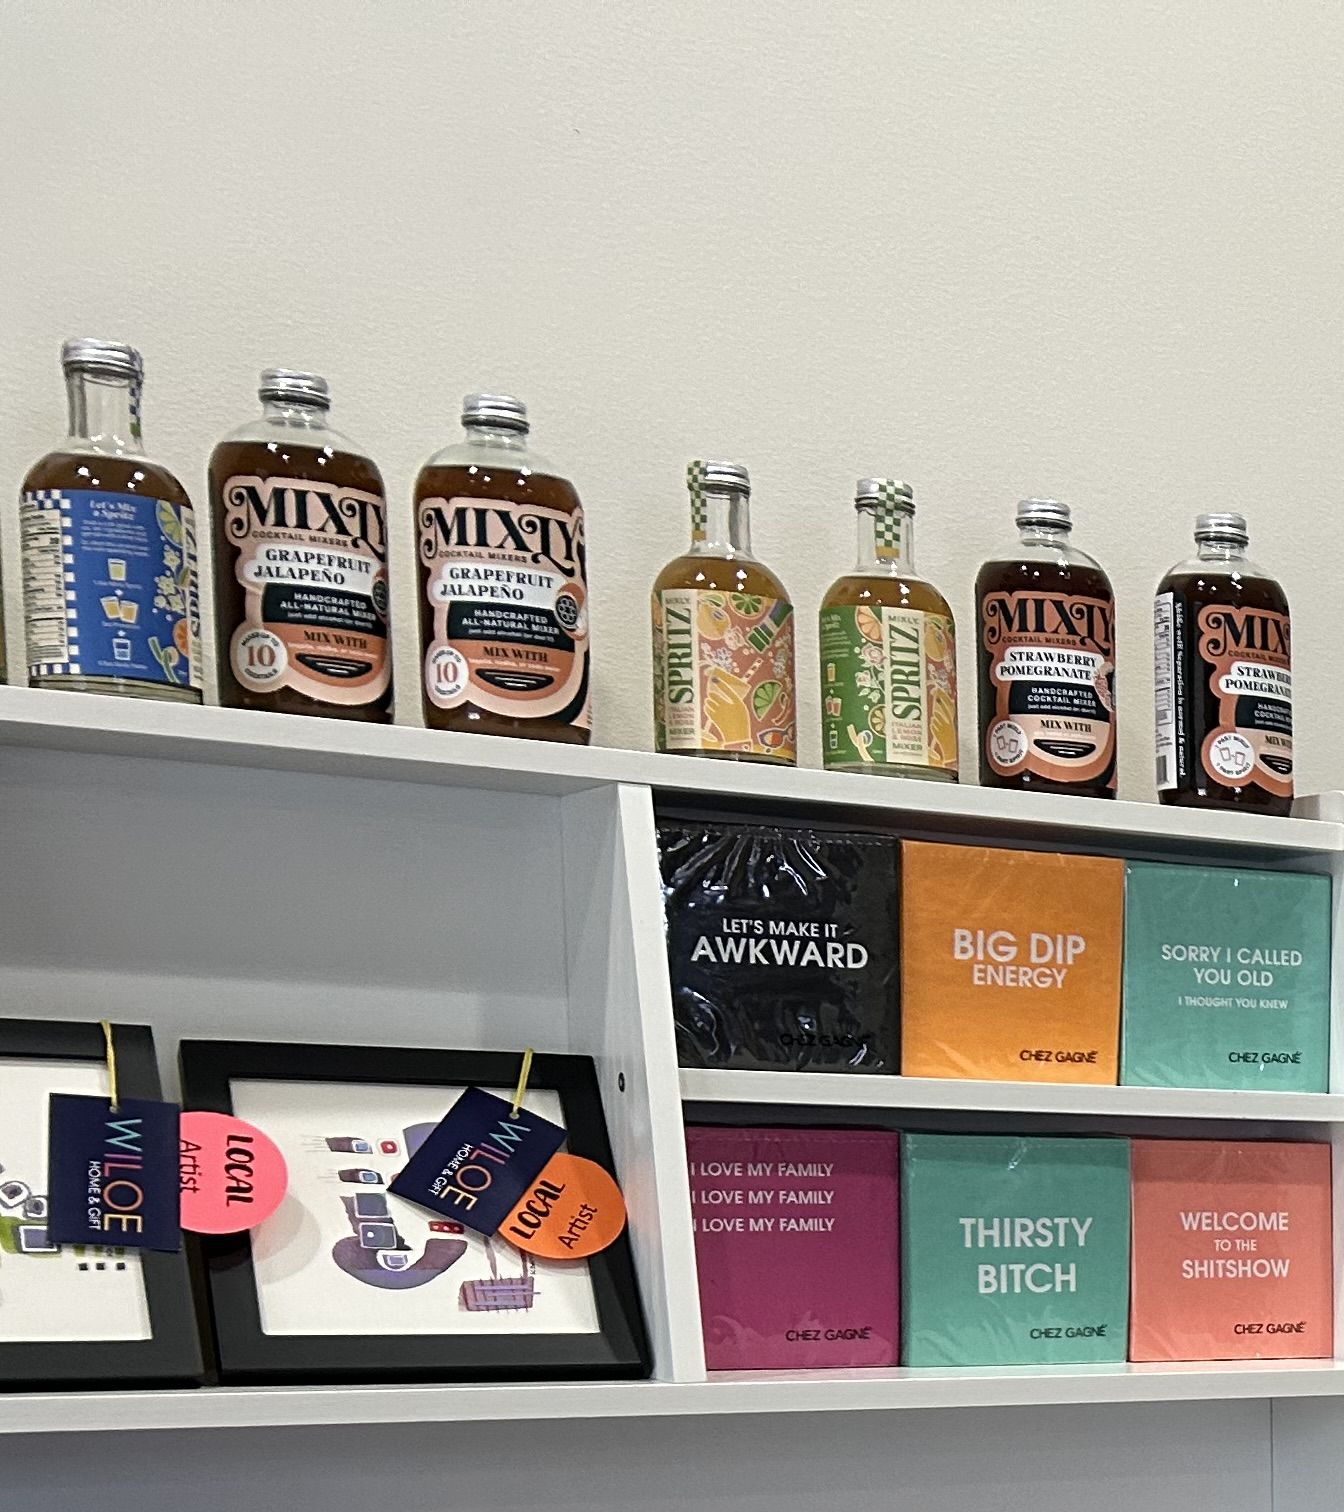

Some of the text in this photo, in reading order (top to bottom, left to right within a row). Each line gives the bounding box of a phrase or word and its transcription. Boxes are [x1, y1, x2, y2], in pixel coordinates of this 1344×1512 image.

[252, 531, 348, 547] COCKTAIL MIXERS
[422, 507, 584, 577] MIXLY
[266, 549, 370, 573] GRAPEFRUIT
[439, 550, 528, 563] COCKTAIL MIXERS
[254, 565, 345, 585] JALAPEÑO
[450, 568, 554, 588] GRAPEFRUIT
[294, 593, 367, 608] HANDCRAFTED
[440, 584, 524, 600] JALAPEÑO
[280, 601, 348, 615] ALL-NATURAL
[474, 609, 548, 624] HANDCRAFTED
[462, 617, 560, 634] ALL-NATURAL MIXER
[304, 631, 367, 649] MIX WITH
[1045, 638, 1077, 646] MIXERS
[248, 645, 276, 666] 10
[483, 646, 547, 662] MIX WITH
[666, 607, 694, 704] SPRITZ
[1010, 652, 1097, 668] STRAWBERRY
[1228, 650, 1266, 660] COCKTAIL
[436, 661, 459, 683] 10
[889, 623, 922, 721] SPRITZ
[1000, 666, 1092, 680] POMEGRANATE
[1027, 694, 1070, 704] COCKTAIL
[1032, 687, 1093, 698] HANDCRAFTED
[1040, 720, 1092, 733] MIX WITH
[892, 743, 922, 751] MIXER
[722, 918, 838, 939] LET'S MAKE IT
[690, 936, 869, 969] AWKWARD
[953, 928, 1086, 965] BIG DIP
[1161, 944, 1303, 966] SORRY I CALLED
[972, 964, 1068, 989] ENERGY
[1193, 967, 1273, 987] YOU OLD
[1184, 996, 1288, 1009] THOUGHT YOU KNEW
[1019, 1050, 1052, 1062] CHEZ
[1228, 1051, 1303, 1064] CHEZ GAGNÉ
[180, 1139, 202, 1194] Artist
[224, 1134, 255, 1207] LOCAL
[428, 1144, 473, 1196] HOME GIFT
[440, 1120, 532, 1211] WILOE
[701, 1163, 834, 1177] LOVE MY FAMILY
[103, 1119, 143, 1233] WILOE
[88, 1160, 101, 1231] HOME GIFT
[701, 1190, 834, 1204] LOVE MY FAMILY
[509, 1179, 566, 1239] LOCAL
[558, 1204, 598, 1250] Artist
[702, 1218, 835, 1232] LOVE MY FAMILY
[1180, 1211, 1289, 1232] WELCOME
[960, 1217, 1093, 1248] THIRSTY
[1214, 1239, 1257, 1251] TO THE
[1182, 1259, 1290, 1279] SHITSHOW
[978, 1263, 1077, 1294] BITCH
[785, 1327, 872, 1342] CHEZ GAGNÉ
[1030, 1324, 1107, 1339] CHEZ GAGNÉ
[1234, 1321, 1306, 1335] CHEZ GAGNÉ
